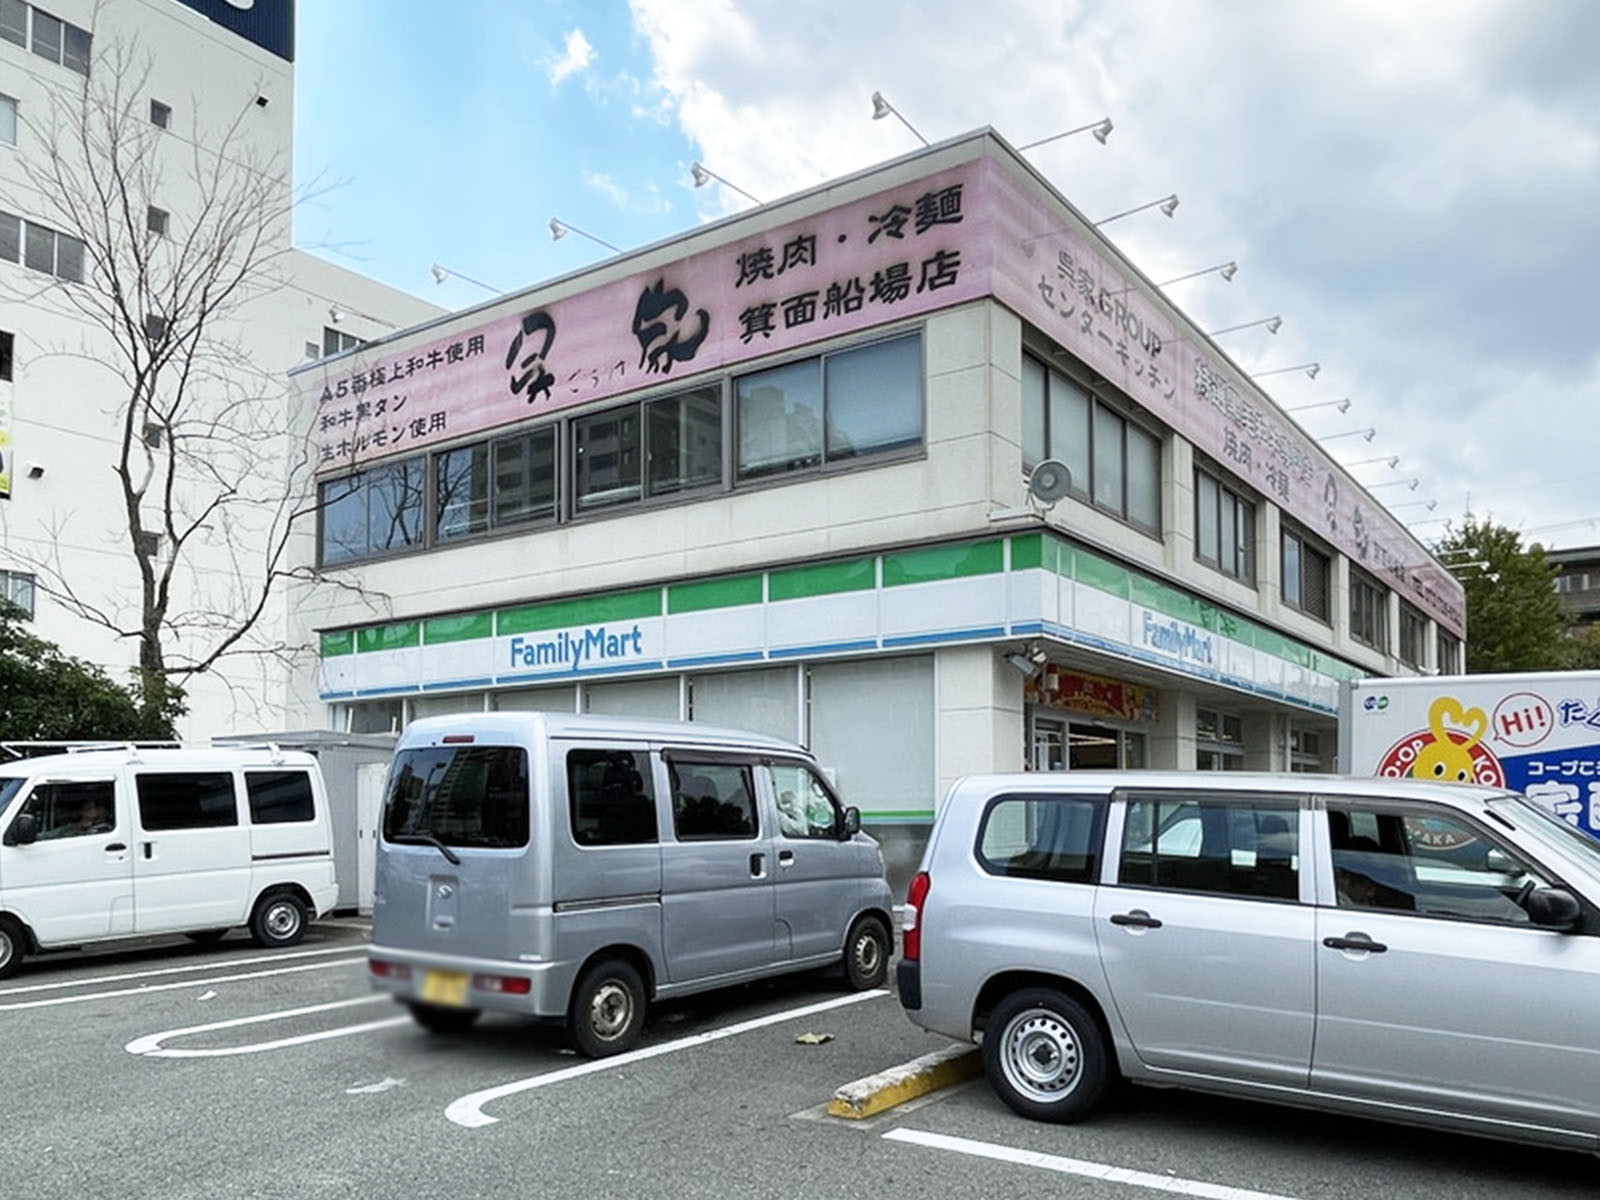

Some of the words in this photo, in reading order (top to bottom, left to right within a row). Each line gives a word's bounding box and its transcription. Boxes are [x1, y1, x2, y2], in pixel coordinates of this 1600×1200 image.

[738, 250, 961, 344] 箕面船場店
[1037, 275, 1176, 399] センターキッチン
[319, 411, 447, 464] 生ホルモン使用
[511, 624, 642, 670] FamilyMart
[1142, 611, 1214, 664] FamilyMart
[1501, 705, 1546, 736] Hi!
